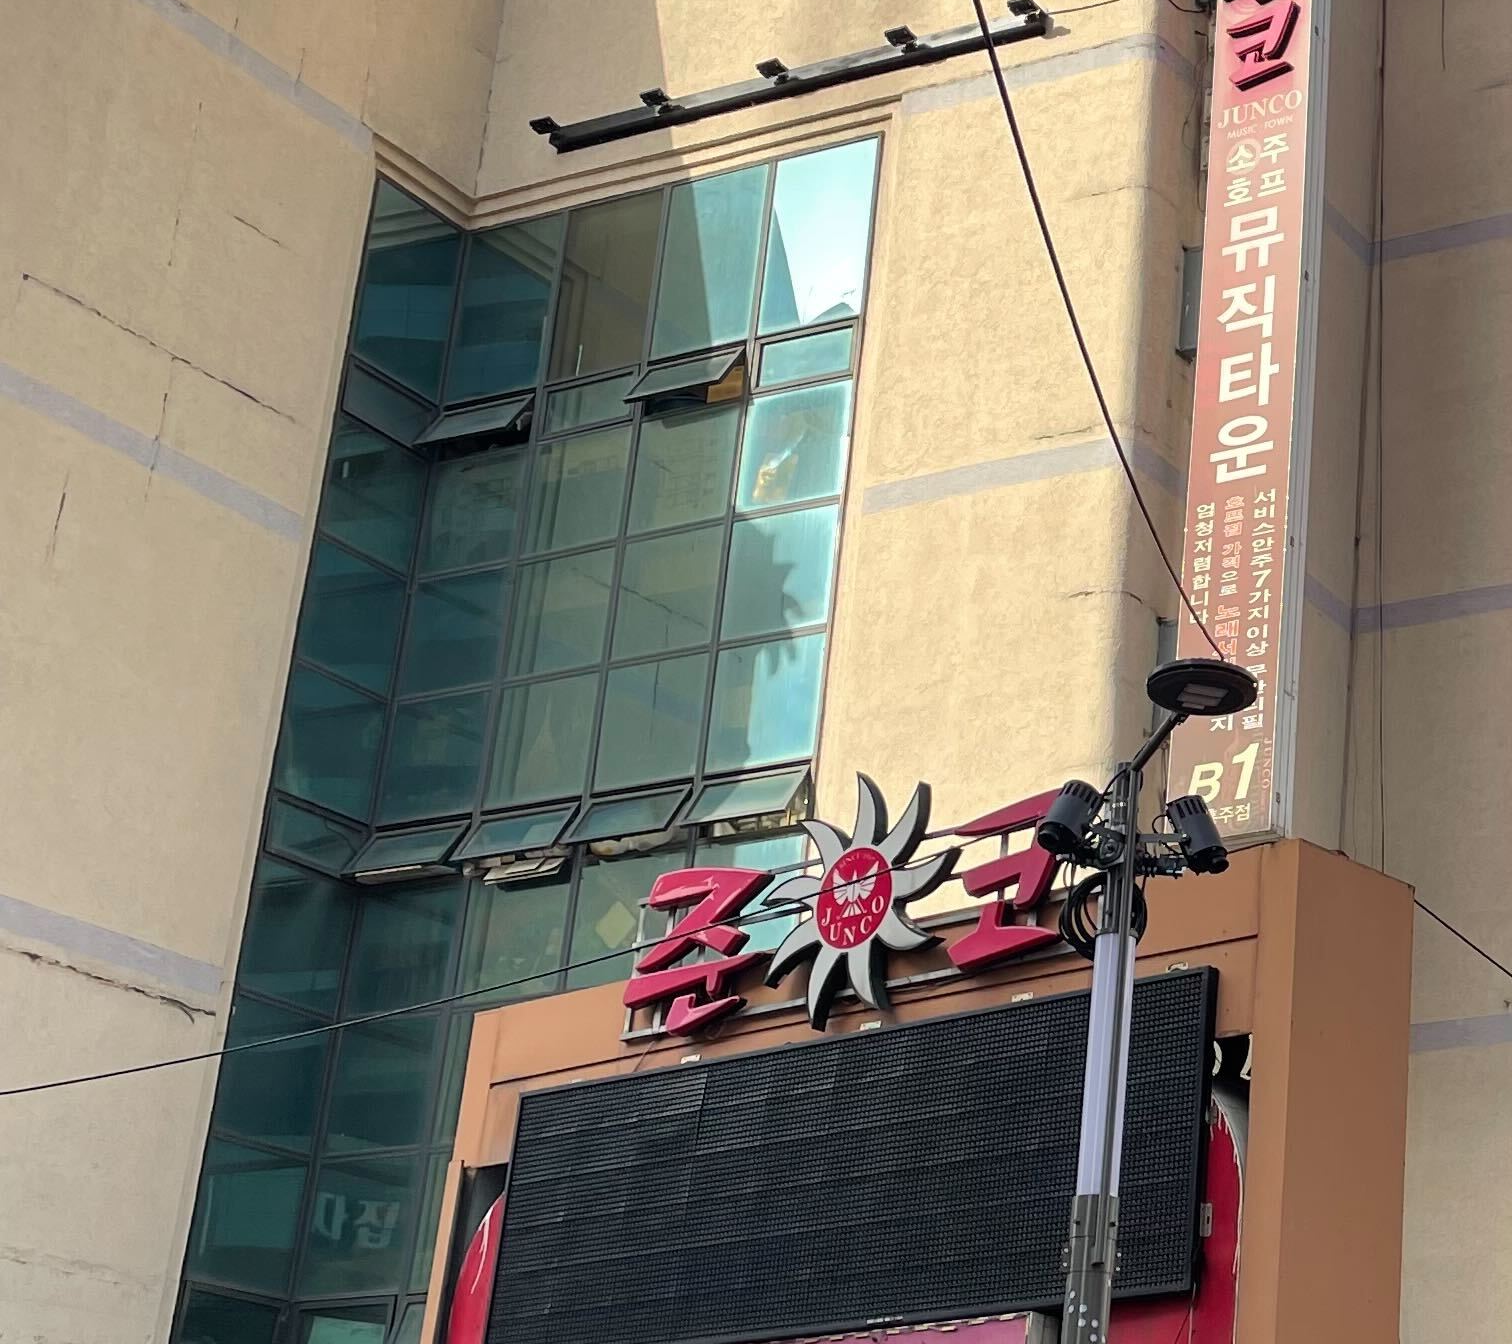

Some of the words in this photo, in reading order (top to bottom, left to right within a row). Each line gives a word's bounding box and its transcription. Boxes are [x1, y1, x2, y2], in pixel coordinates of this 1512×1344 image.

[1217, 89, 1303, 129] JUNCO
[1226, 123, 1258, 141] MUSIC
[1263, 114, 1294, 131] TOWN
[1209, 205, 1286, 485] 뮤직타운
[1187, 742, 1260, 805] B1
[821, 895, 885, 947] JUNCO
